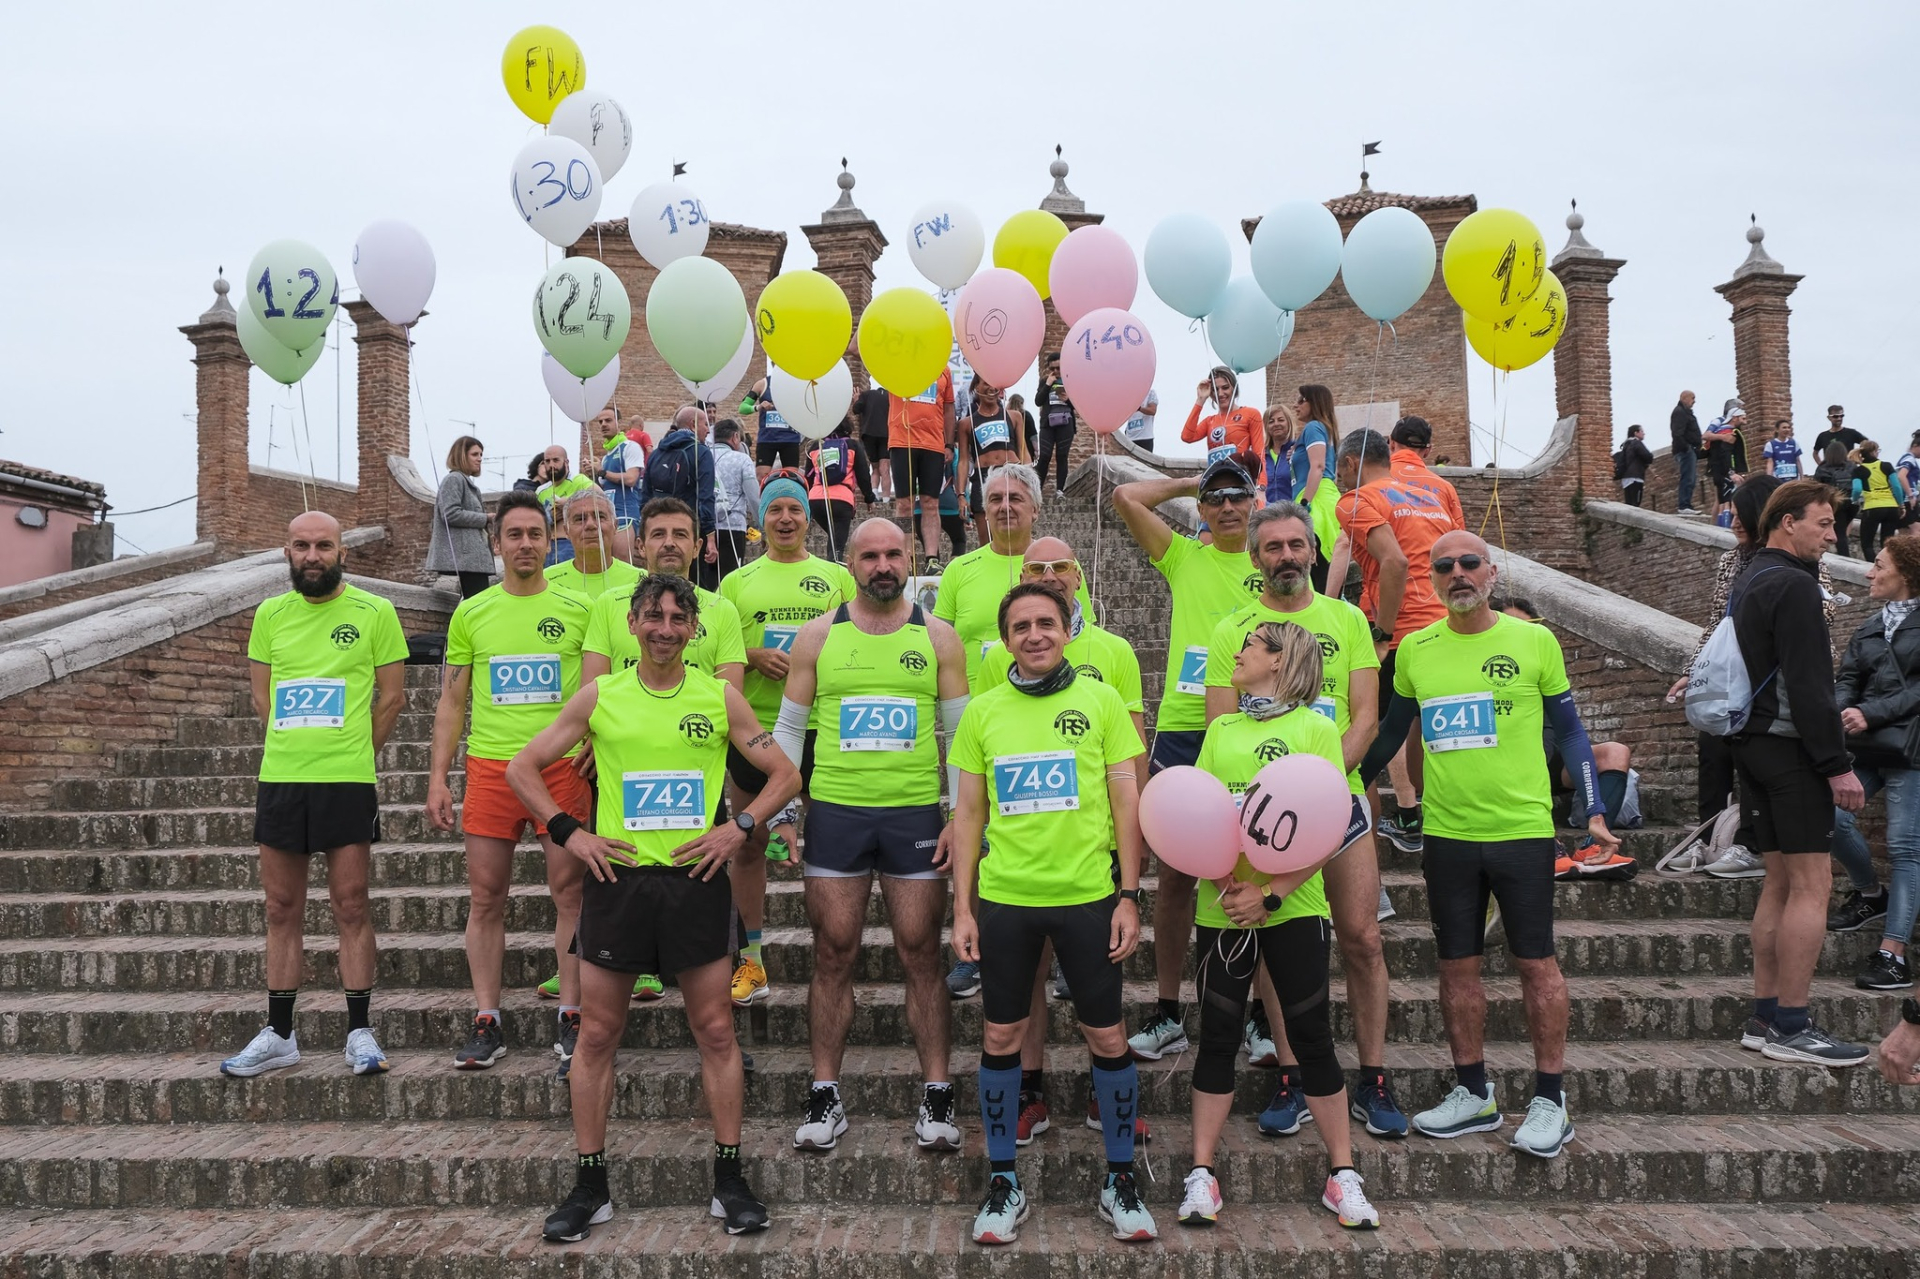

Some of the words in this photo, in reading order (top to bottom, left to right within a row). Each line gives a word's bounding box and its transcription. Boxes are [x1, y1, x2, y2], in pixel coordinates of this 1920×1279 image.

[512, 158, 593, 225] 1:30
[1076, 322, 1145, 362] 1:40
[981, 425, 1006, 438] 528
[496, 663, 554, 687] 900
[283, 687, 336, 712] 527
[848, 707, 908, 732] 750
[1431, 704, 1480, 732] 641
[1004, 763, 1066, 793] 746
[635, 782, 693, 809] 742
